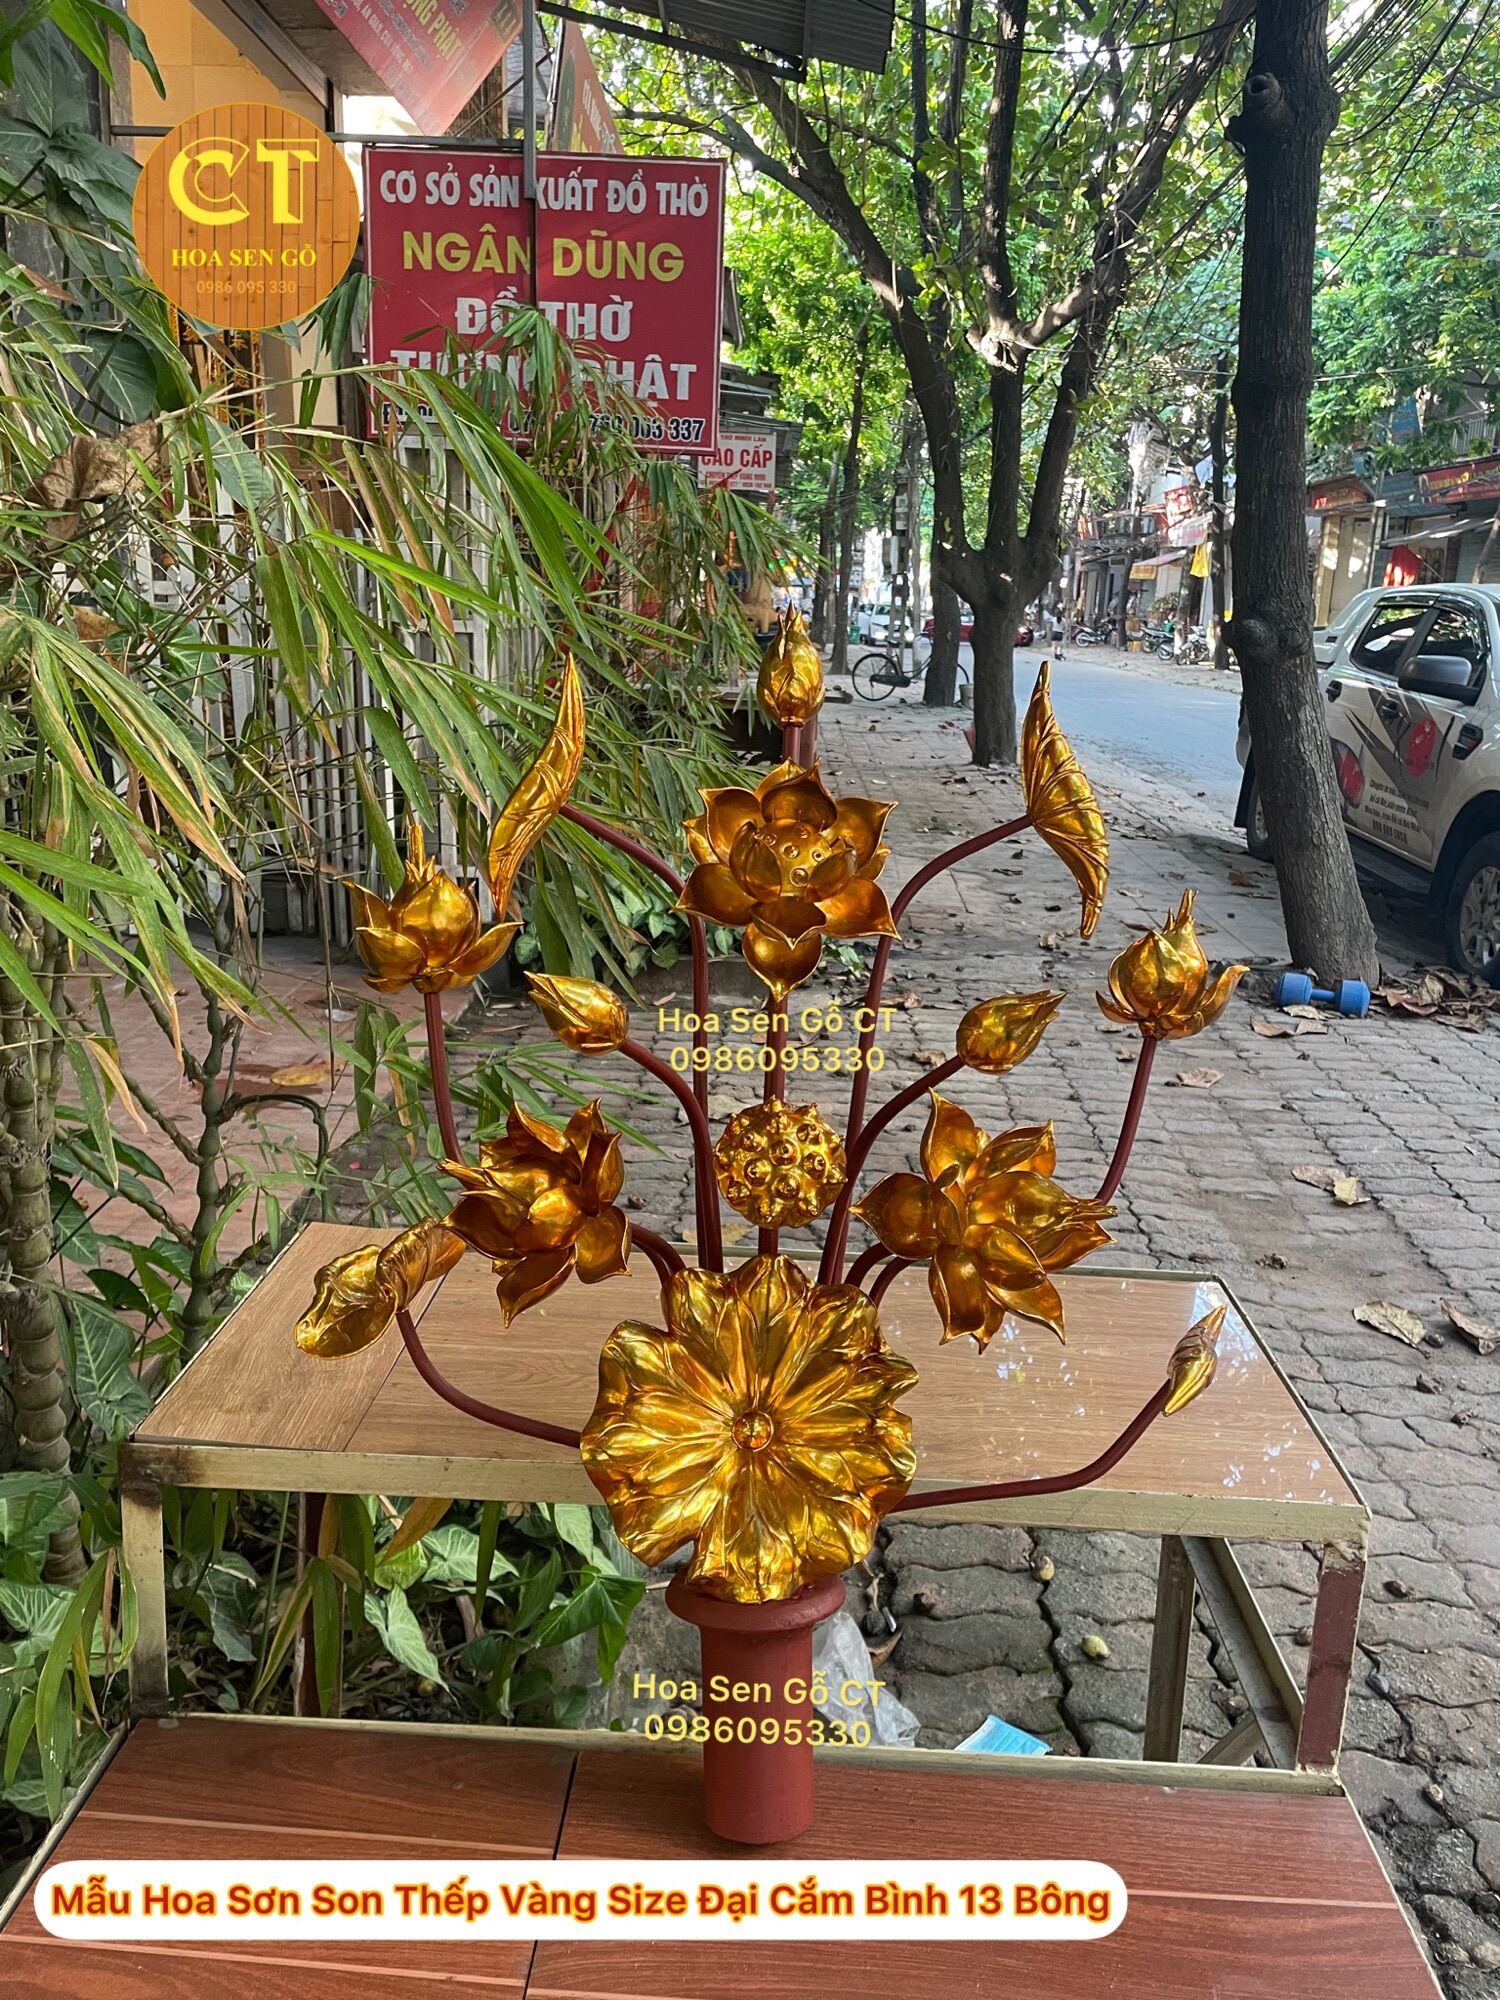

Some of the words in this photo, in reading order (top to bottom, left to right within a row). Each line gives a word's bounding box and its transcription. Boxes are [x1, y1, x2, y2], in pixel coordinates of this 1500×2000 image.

[380, 169, 417, 204] CƠ
[425, 162, 461, 206] SỞ
[469, 164, 520, 208] SẢN
[535, 166, 598, 212] XUẤT
[606, 169, 647, 214] ĐỒ
[656, 176, 709, 217] THỜ
[403, 223, 531, 275] NGÂN
[553, 230, 685, 282] DŨNG
[538, 295, 633, 342] THỜ
[668, 417, 704, 441] 337
[740, 444, 772, 468] CẤP
